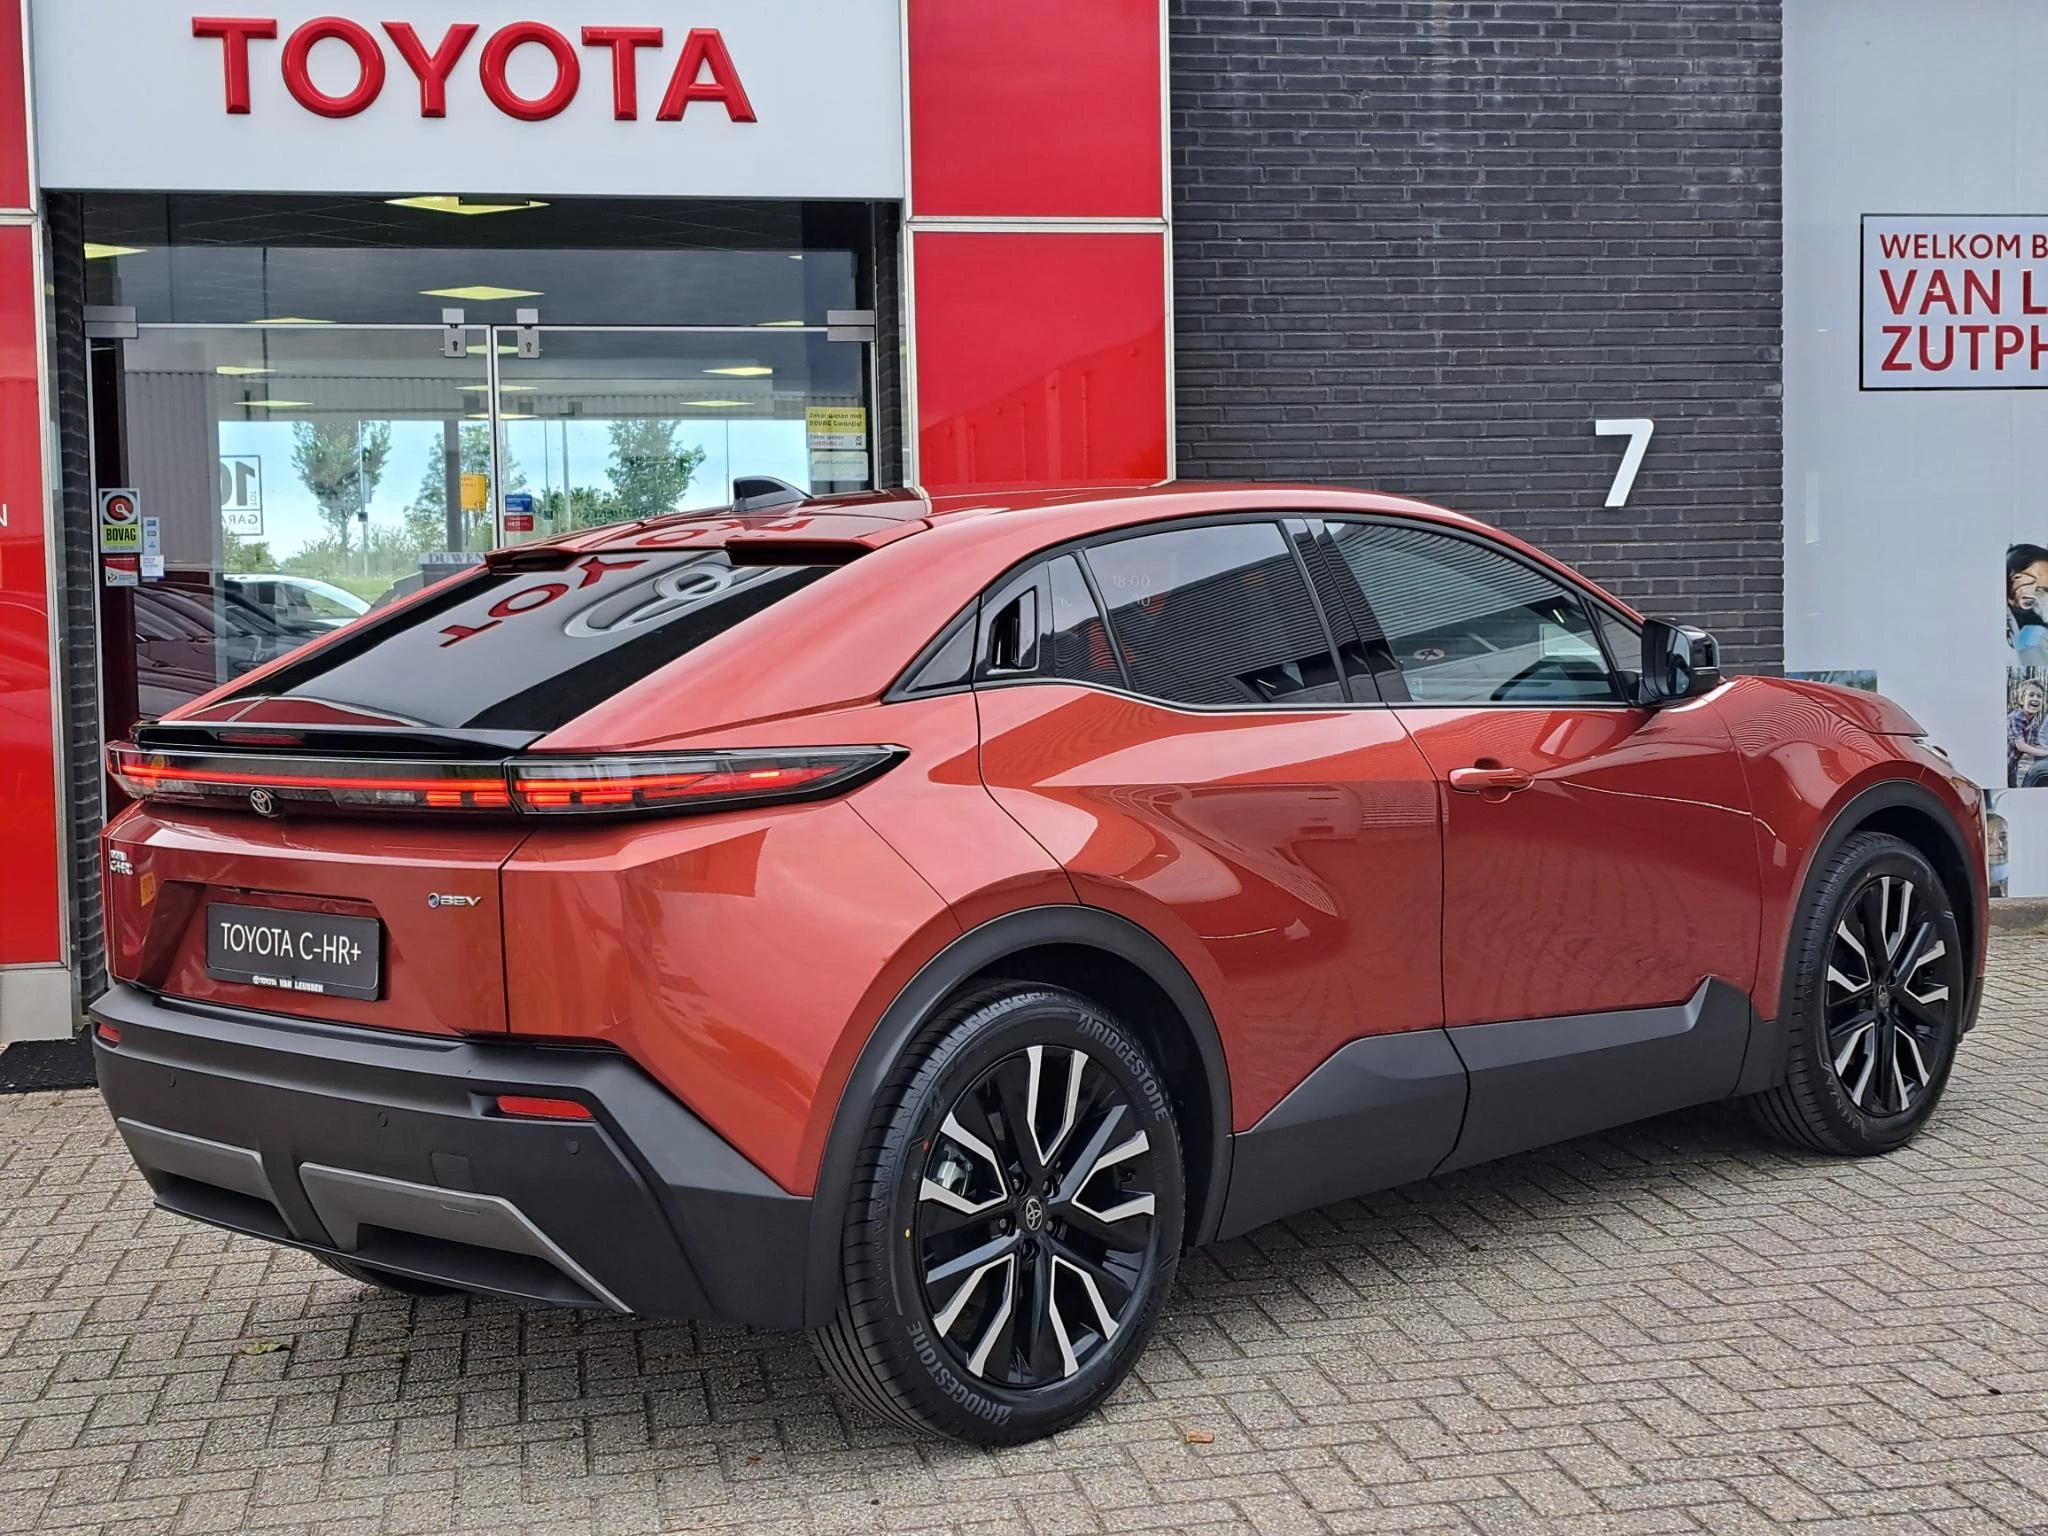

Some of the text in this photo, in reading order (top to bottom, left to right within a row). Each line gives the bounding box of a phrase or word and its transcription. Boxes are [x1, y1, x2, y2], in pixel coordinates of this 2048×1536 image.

[191, 16, 758, 123] TOYOTA
[1880, 234, 2021, 259] WELKOM
[1879, 269, 2001, 315] VAN
[1595, 419, 1654, 508] 7
[106, 528, 136, 542] BOVAG
[220, 922, 362, 966] TOYOTA C-HR+
[279, 979, 293, 989] VAN
[294, 980, 324, 993] LEUSSEN
[1076, 1012, 1169, 1122] BRIDGESTONE
[906, 1319, 1013, 1427] BRIDGESTONE
